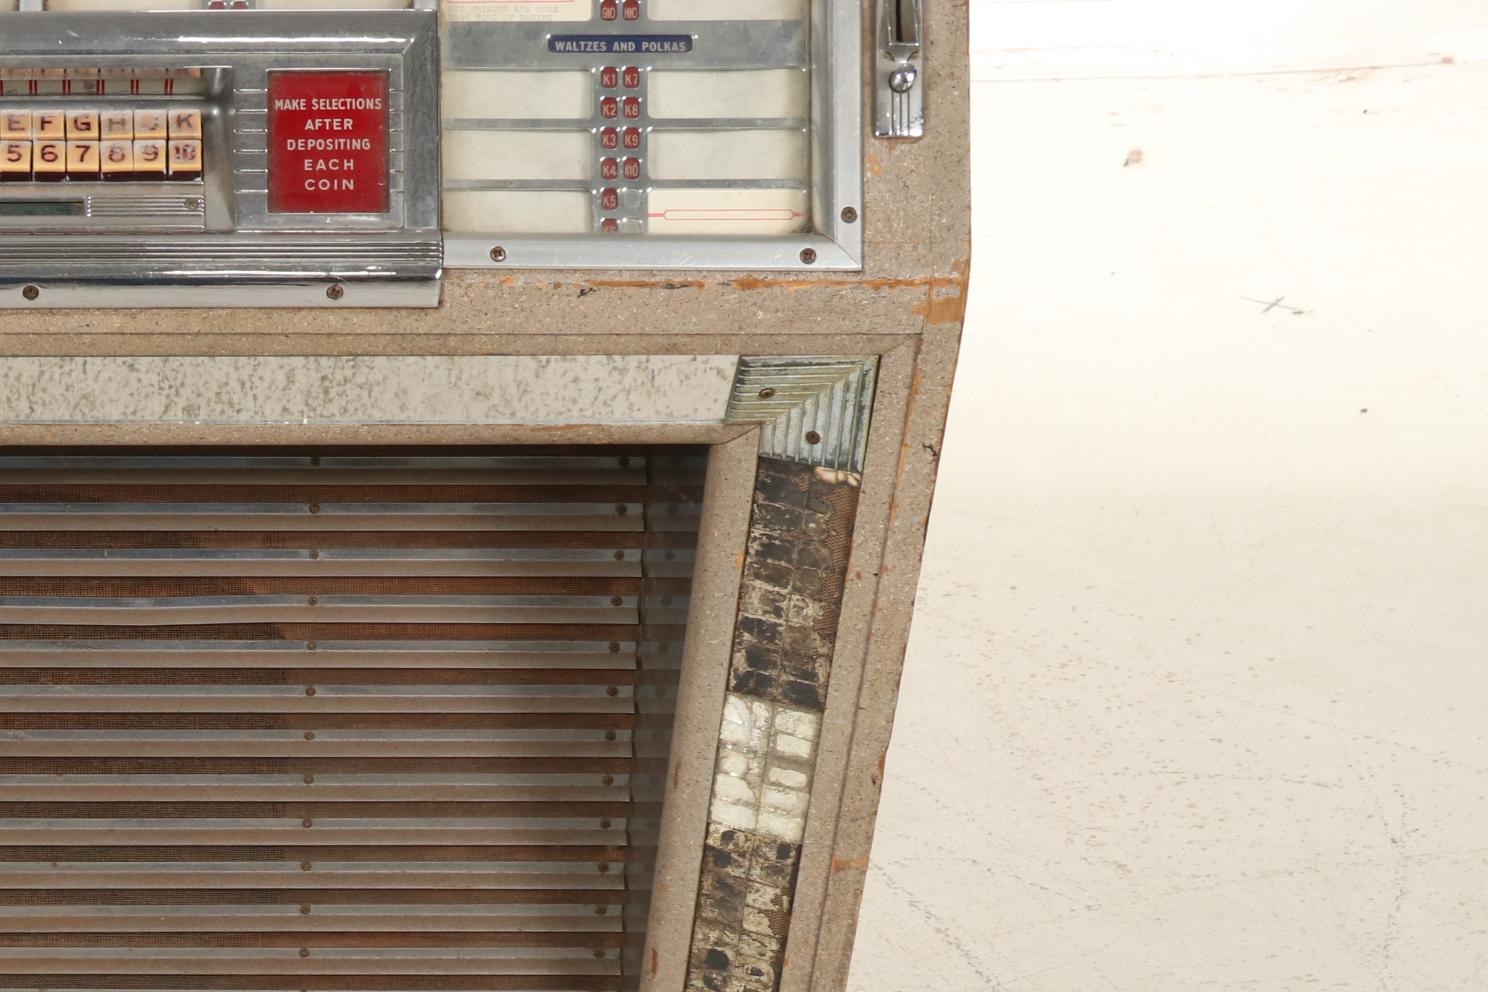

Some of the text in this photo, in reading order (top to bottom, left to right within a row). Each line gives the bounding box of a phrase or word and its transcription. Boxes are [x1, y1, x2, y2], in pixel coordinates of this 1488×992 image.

[602, 7, 616, 19] G10
[624, 7, 638, 19] H10
[555, 41, 686, 52] WALTZES AND POLKAS
[603, 74, 616, 85] K1
[625, 74, 638, 85] K7
[274, 98, 382, 110] MAKE SELECTIONS
[603, 104, 616, 116] K2
[625, 104, 638, 116] K8
[7, 114, 25, 131] E
[40, 115, 56, 131] F
[74, 115, 91, 132] G
[108, 117, 125, 131] H
[176, 113, 193, 129] K
[304, 119, 353, 131] AFTER
[287, 138, 371, 151] DEPOSITING
[602, 134, 616, 146] K3
[624, 134, 639, 146] K9
[7, 144, 22, 162] 5
[40, 145, 58, 162] 6
[75, 145, 91, 162] 7
[108, 145, 125, 162] 8
[143, 145, 159, 162] 9
[304, 159, 354, 171] EACH
[602, 165, 617, 177] K4
[304, 179, 354, 191] COIN
[602, 195, 617, 207] K5
